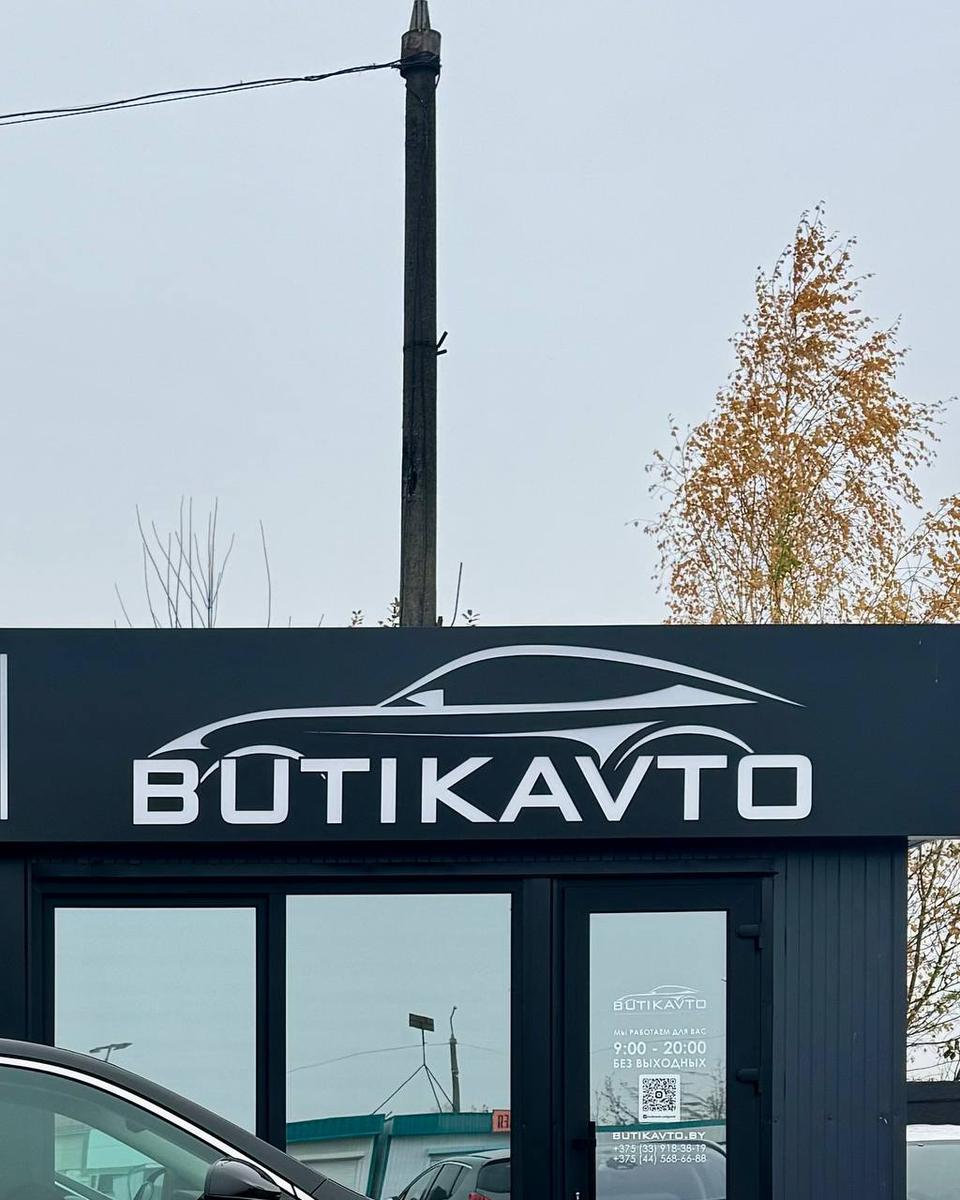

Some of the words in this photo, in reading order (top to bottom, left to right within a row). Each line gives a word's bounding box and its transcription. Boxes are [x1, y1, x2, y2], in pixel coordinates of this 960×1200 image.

[132, 752, 814, 826] BUTIKAVTO
[613, 999, 707, 1011] BUTIKAVTO
[629, 1028, 670, 1036] РАБОТАЕМ
[672, 1028, 689, 1036] ДЛЯ
[613, 1041, 647, 1055] 9:00
[663, 1041, 706, 1055] 20:00
[613, 1058, 632, 1069] БЕЗ
[636, 1058, 706, 1069] ВЫХОДНЫХ
[612, 1131, 707, 1140] BUTIKAVTO.BY
[613, 1144, 636, 1153] +375
[639, 1143, 657, 1155] (33)
[613, 1155, 636, 1164] +375
[639, 1154, 657, 1165] (44)
